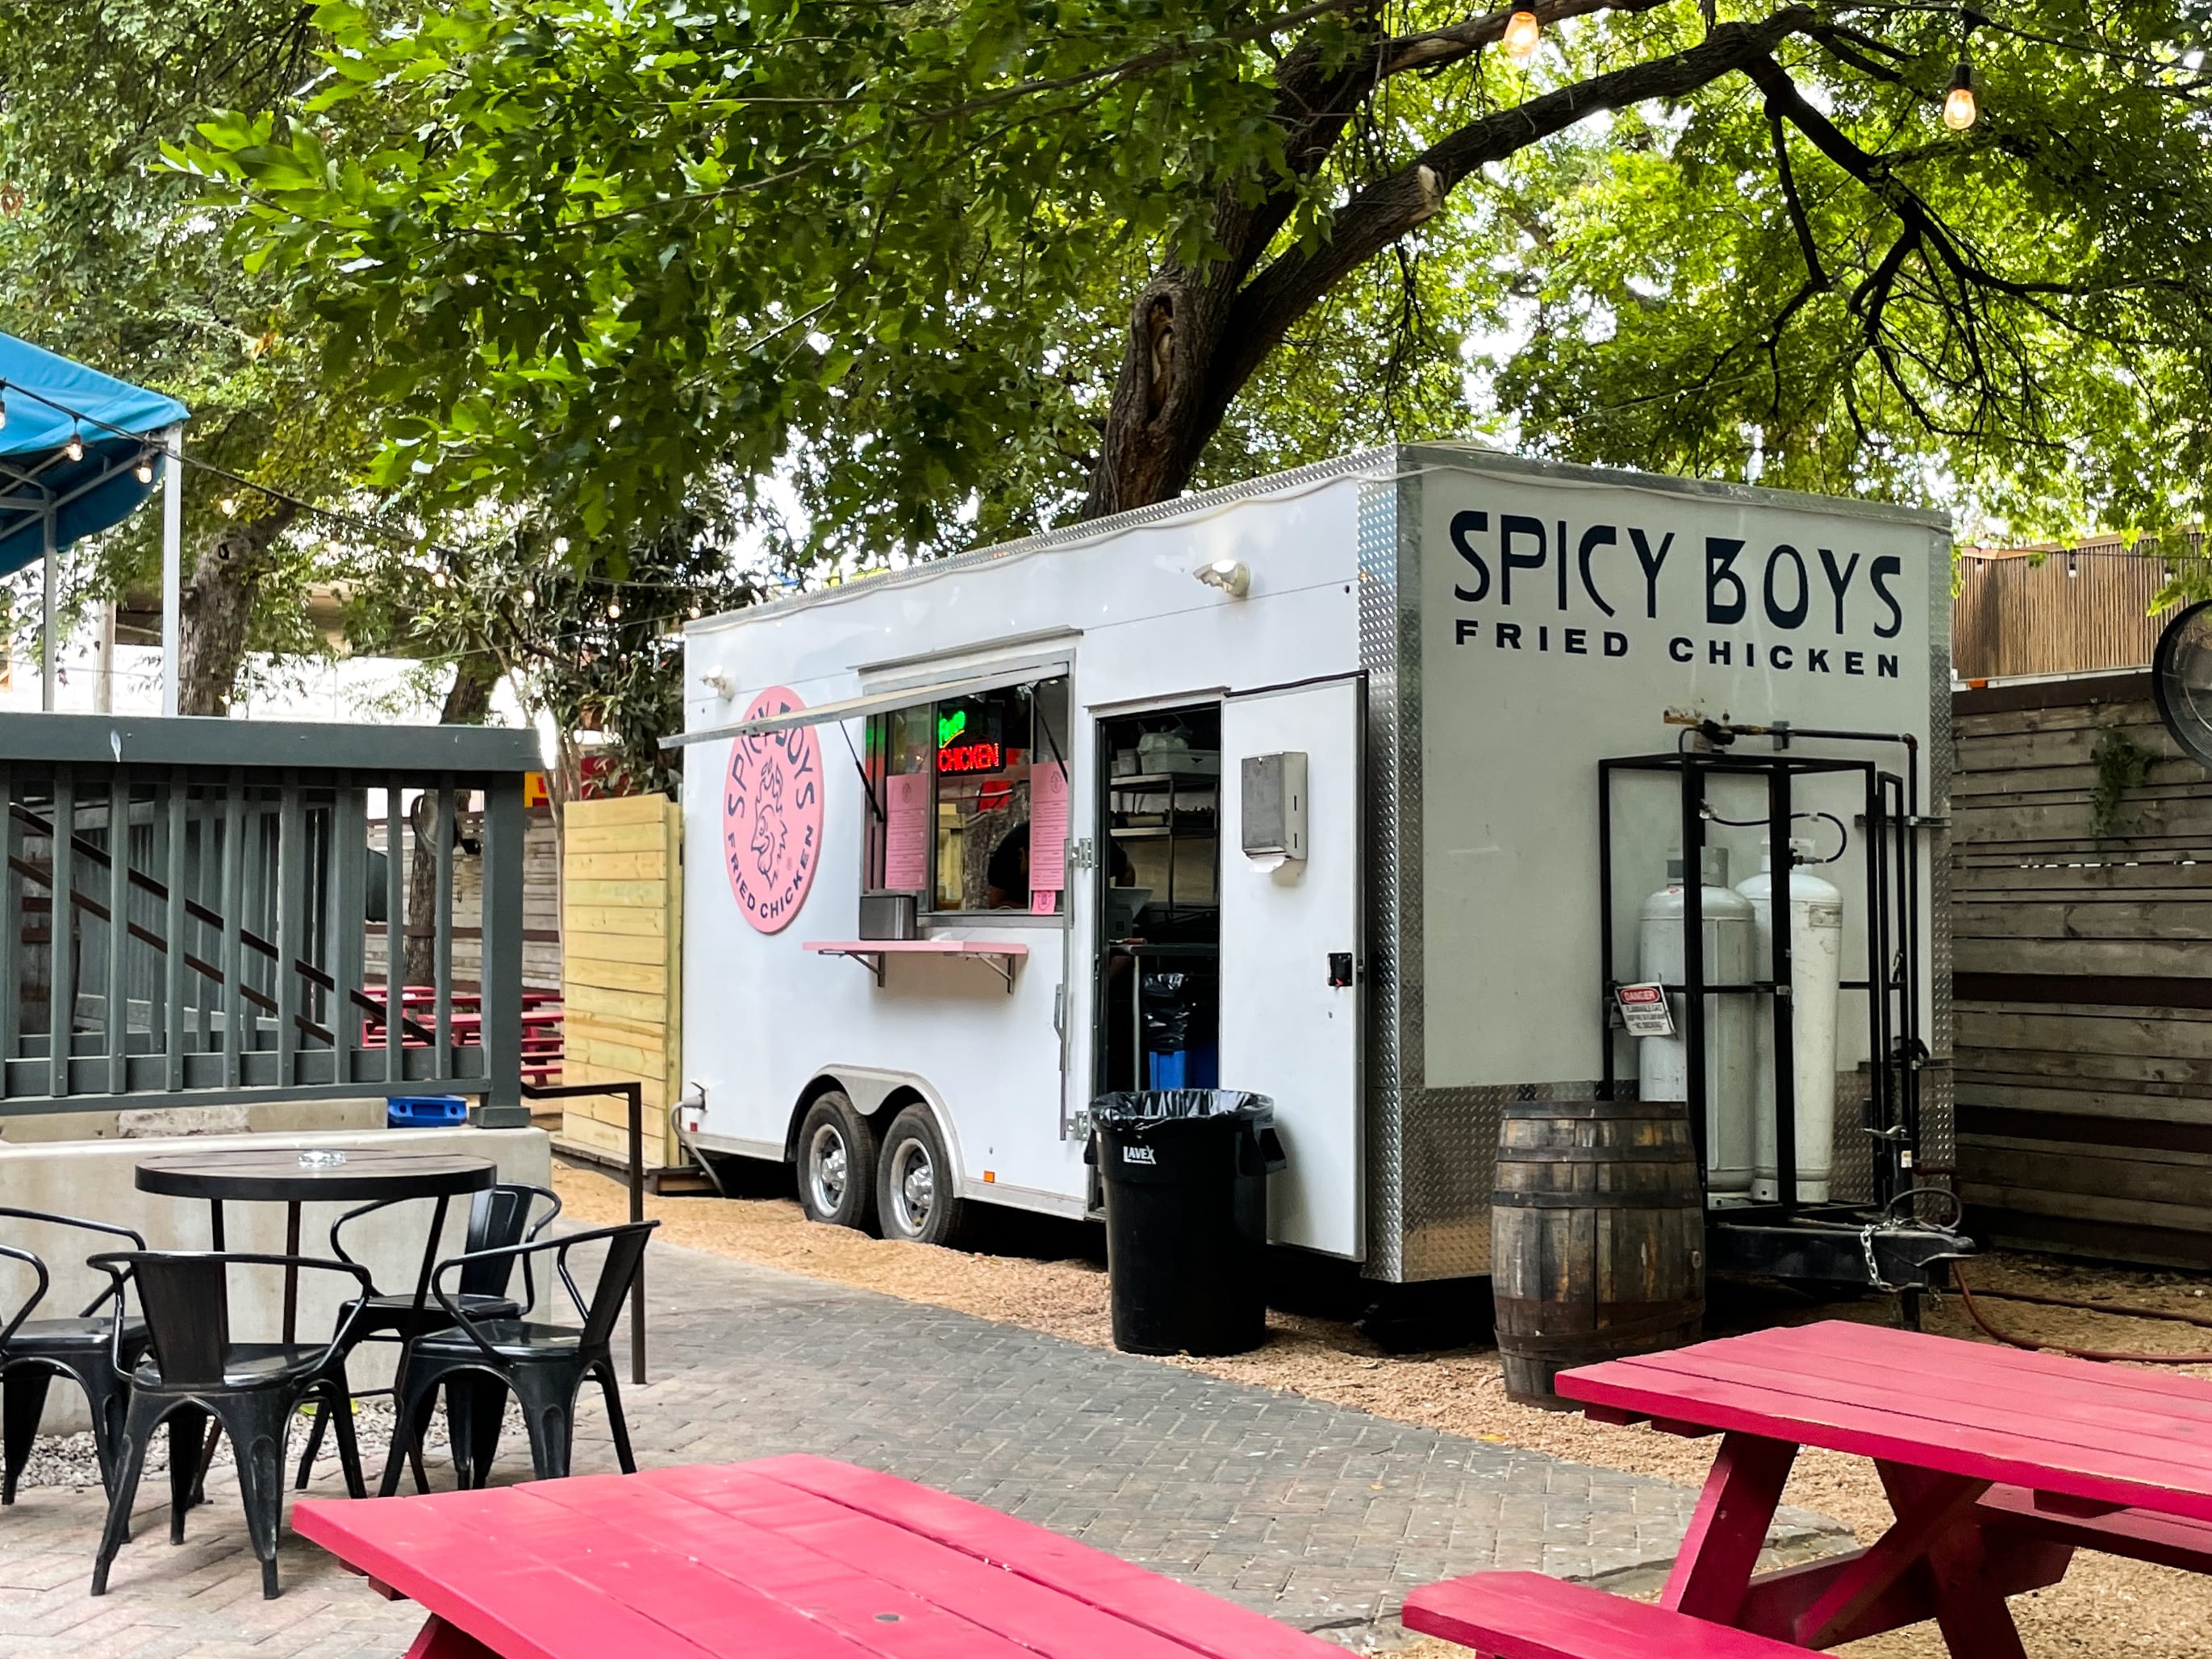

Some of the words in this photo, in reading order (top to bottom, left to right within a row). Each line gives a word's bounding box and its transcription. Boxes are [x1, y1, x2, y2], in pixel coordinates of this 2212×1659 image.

[1450, 511, 1676, 619] SPICY
[1705, 537, 1903, 639] BOYS
[1455, 619, 1629, 657] FRIED
[1668, 636, 1898, 678] CHICKEN
[938, 743, 1000, 772] CHICKEN
[728, 832, 756, 911] FRIED
[760, 824, 813, 919] CHICKEN
[1623, 990, 1656, 1002] DANGER
[1123, 1144, 1157, 1165] LAVEX
